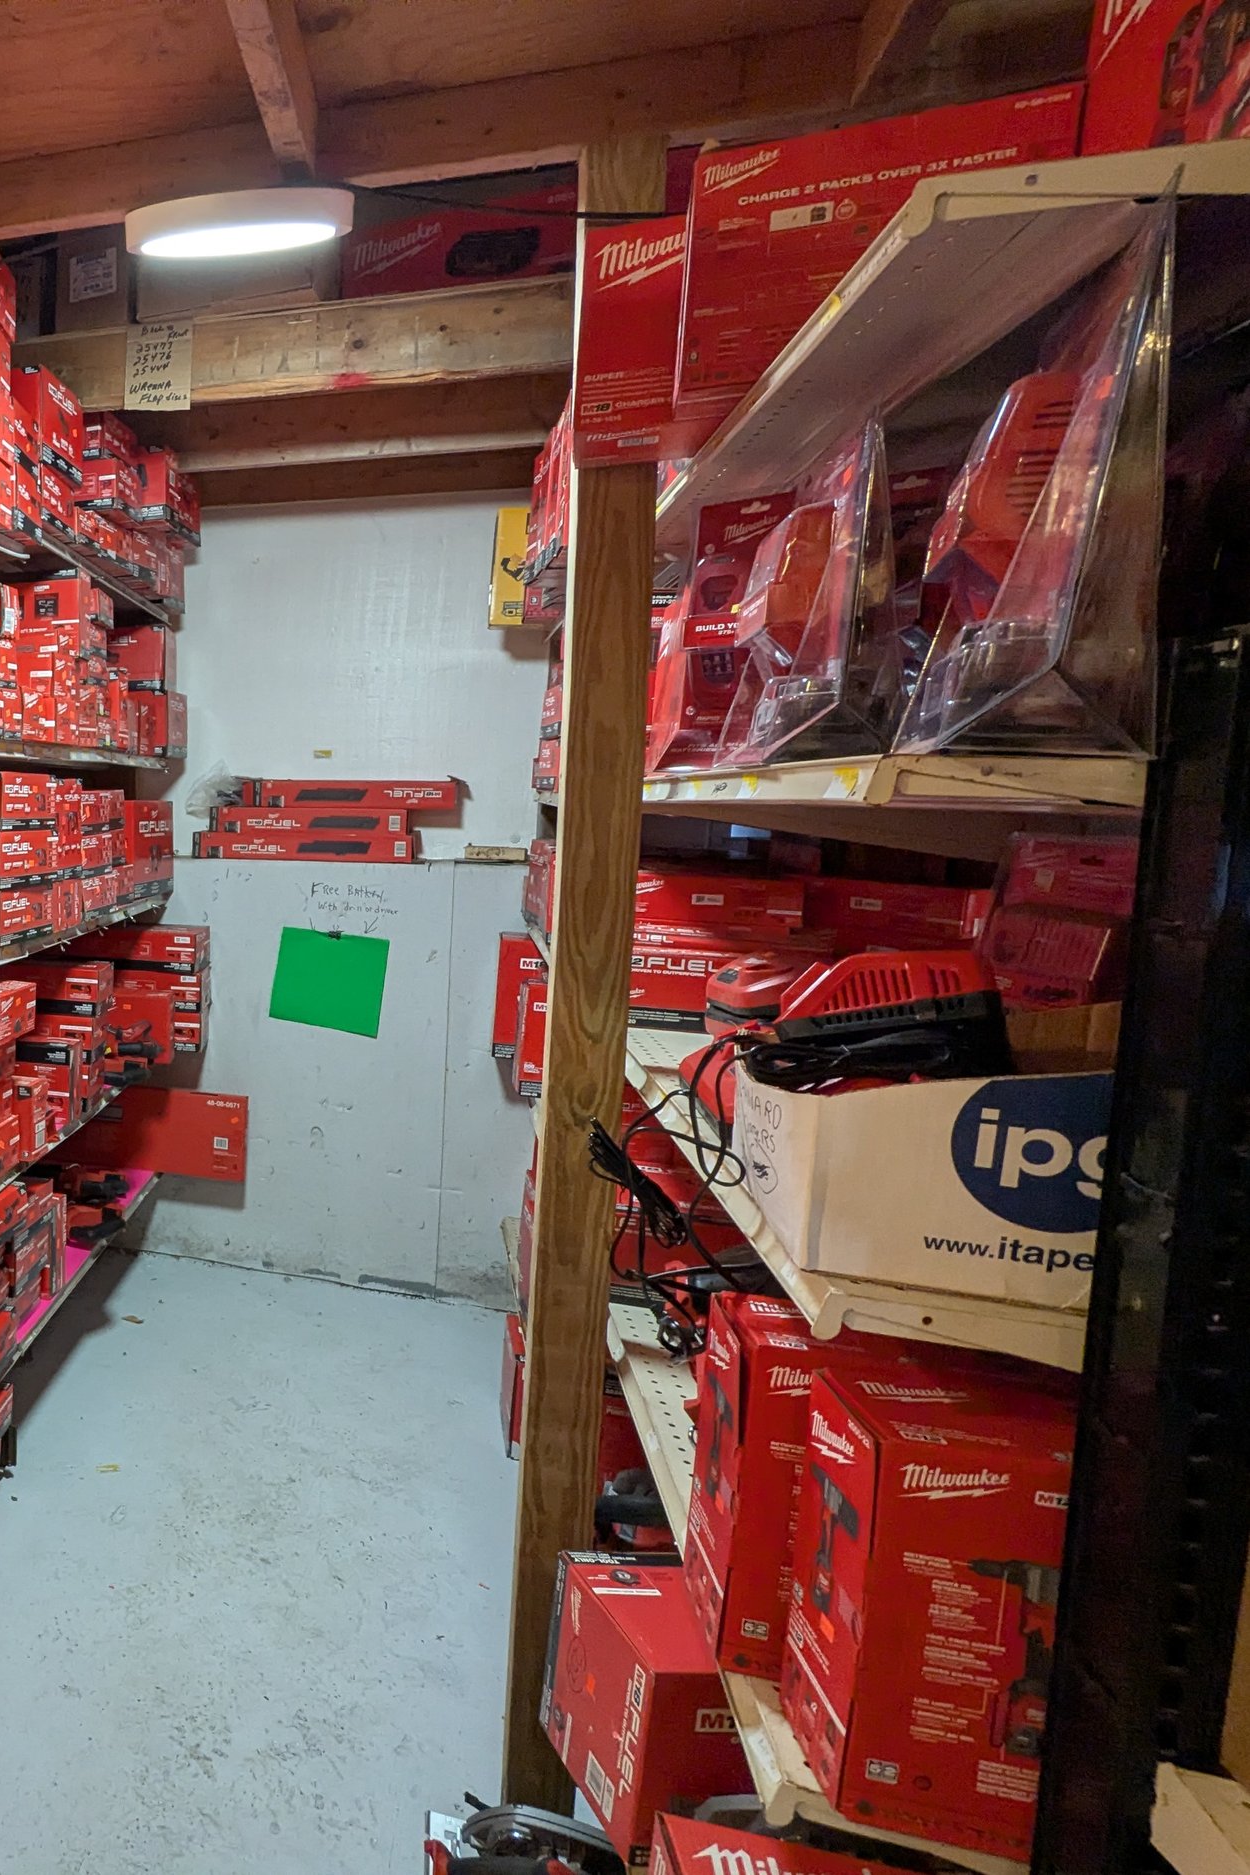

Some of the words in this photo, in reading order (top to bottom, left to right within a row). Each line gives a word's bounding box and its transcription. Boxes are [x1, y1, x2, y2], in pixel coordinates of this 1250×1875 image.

[702, 148, 782, 189] Milwaukee
[737, 187, 801, 206] CHARGE
[804, 184, 817, 195] 2
[819, 173, 874, 192] PACKS
[877, 165, 922, 182] OVER
[953, 147, 1018, 167] FASTER
[353, 220, 442, 272] Milwaukee
[594, 230, 687, 280] Milwau
[724, 515, 780, 542] Milwaukee
[695, 623, 725, 634] BUILD
[264, 818, 301, 827] FUEL
[249, 843, 286, 852] FUEL
[648, 956, 720, 973] FUEL
[923, 1234, 1095, 1273] www.itape
[810, 1409, 855, 1457] Milwaukee
[899, 1462, 1011, 1490] Milwaukee
[618, 1706, 641, 1798] FUEL
